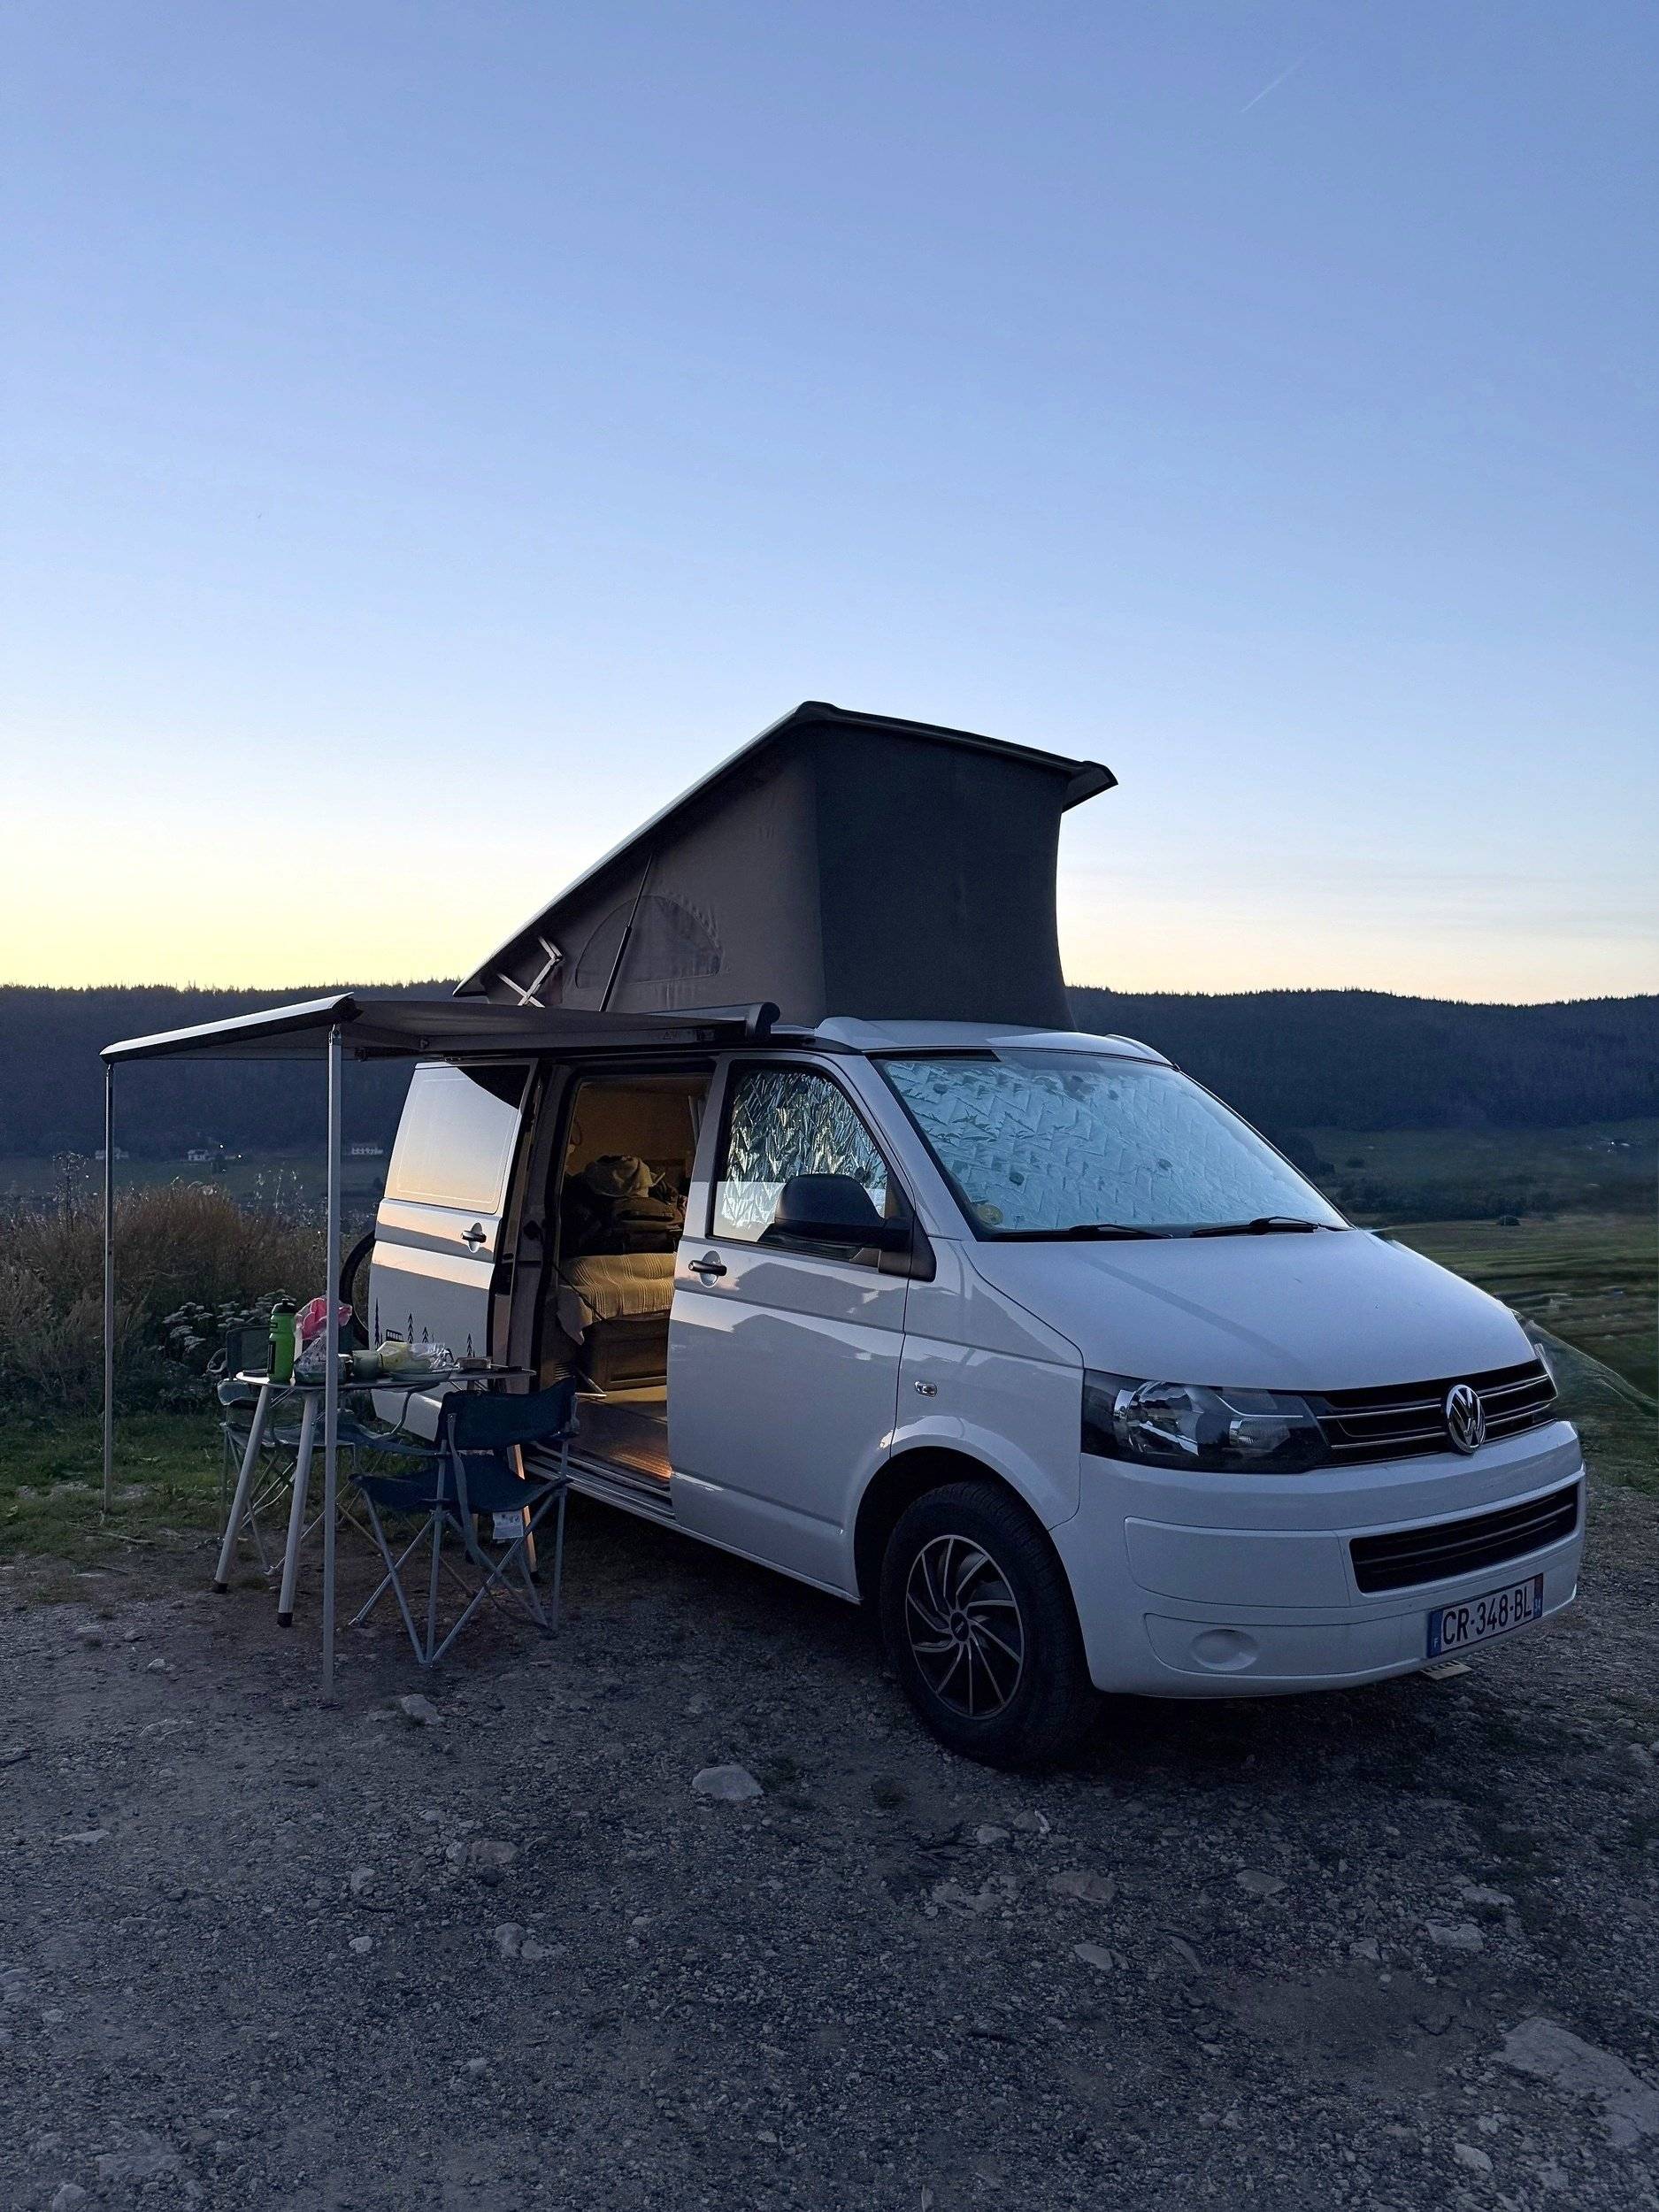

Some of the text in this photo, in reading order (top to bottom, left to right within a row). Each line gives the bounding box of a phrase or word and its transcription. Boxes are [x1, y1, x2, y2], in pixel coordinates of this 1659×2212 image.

[1447, 1385, 1486, 1453] VW
[1433, 1637, 1439, 1648] F
[1443, 1586, 1532, 1645] CR-348-BL
